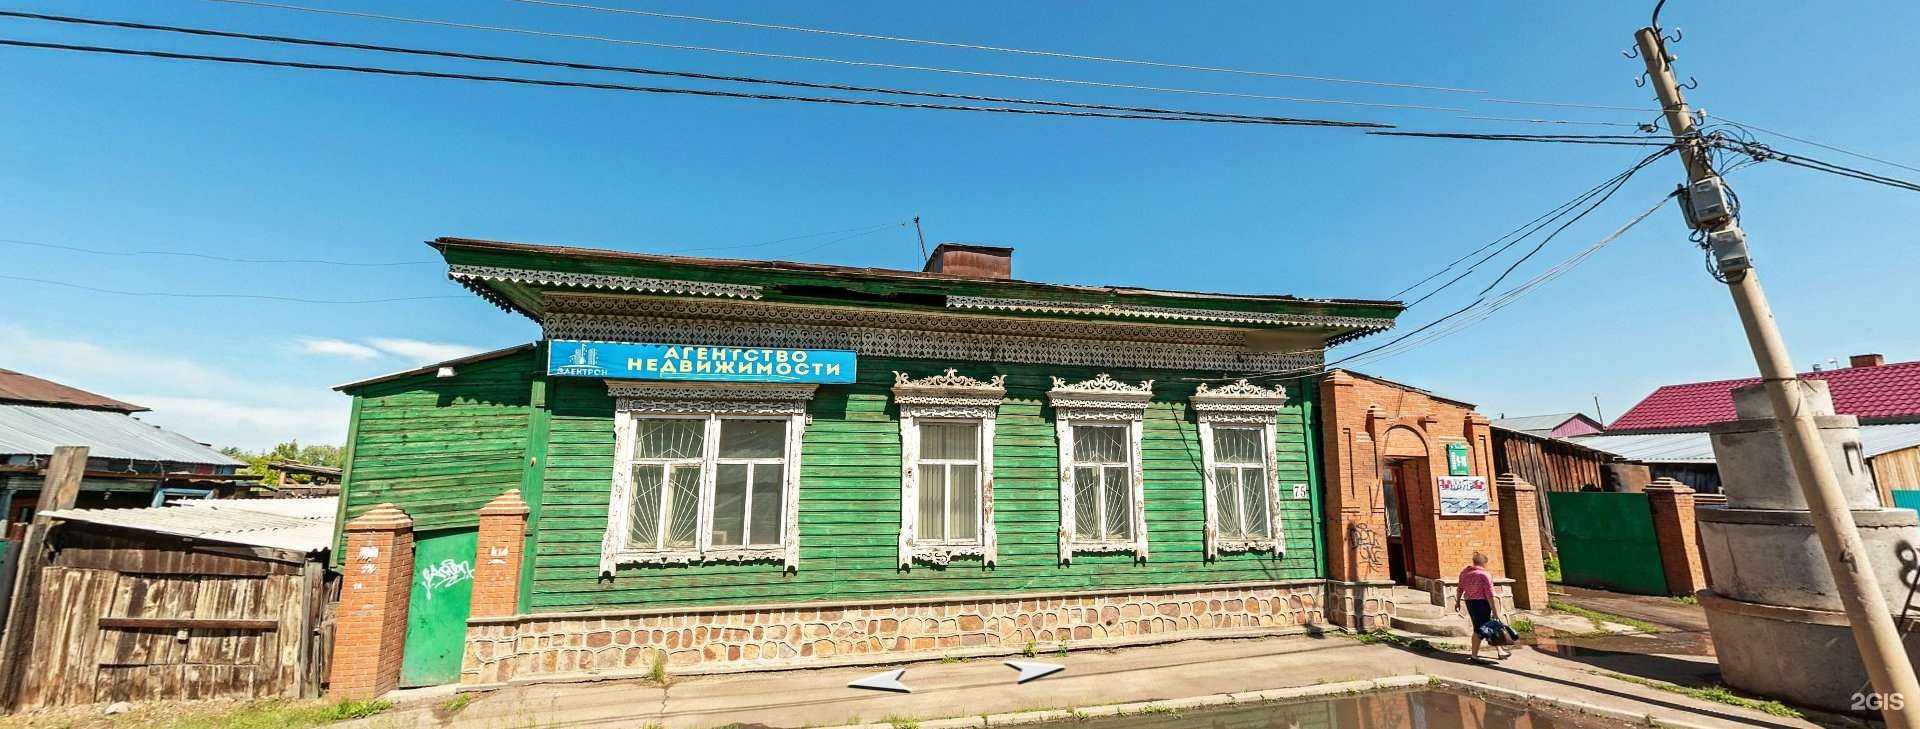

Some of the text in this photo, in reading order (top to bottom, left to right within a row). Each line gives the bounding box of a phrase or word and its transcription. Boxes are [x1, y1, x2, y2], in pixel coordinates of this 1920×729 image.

[663, 347, 808, 363] АГЕНТСТВО
[556, 367, 608, 376] ЭЛЕКТРОН
[627, 357, 841, 375] НЕДВИЖИМОСТИ
